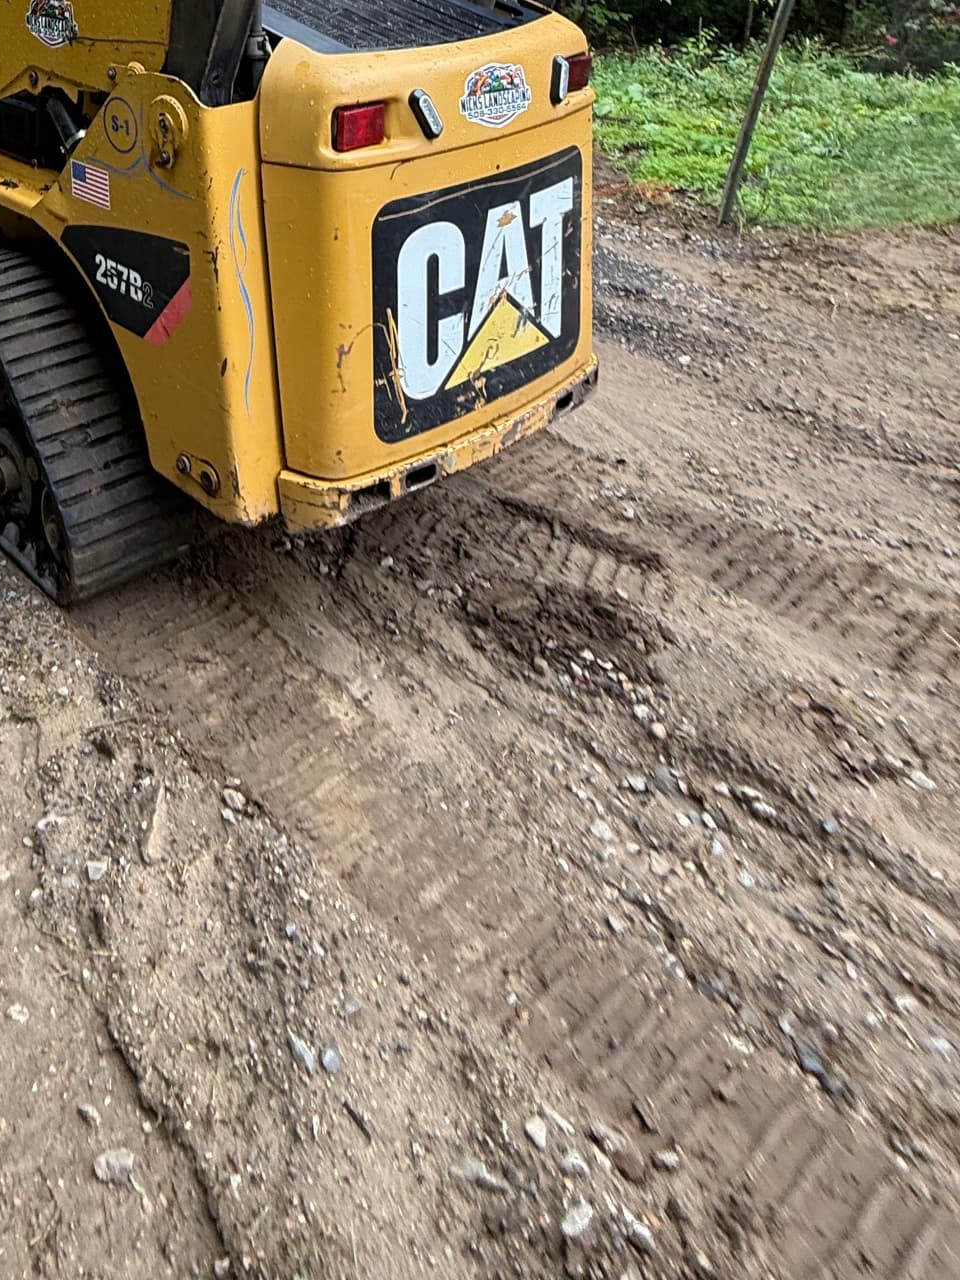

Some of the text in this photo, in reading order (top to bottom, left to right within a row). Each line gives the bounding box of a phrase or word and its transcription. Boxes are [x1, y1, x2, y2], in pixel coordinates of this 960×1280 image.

[460, 88, 530, 112] NICKS LANDSCAPING
[111, 114, 130, 136] S-1
[95, 253, 154, 309] 257B2
[396, 176, 574, 401] CAT
